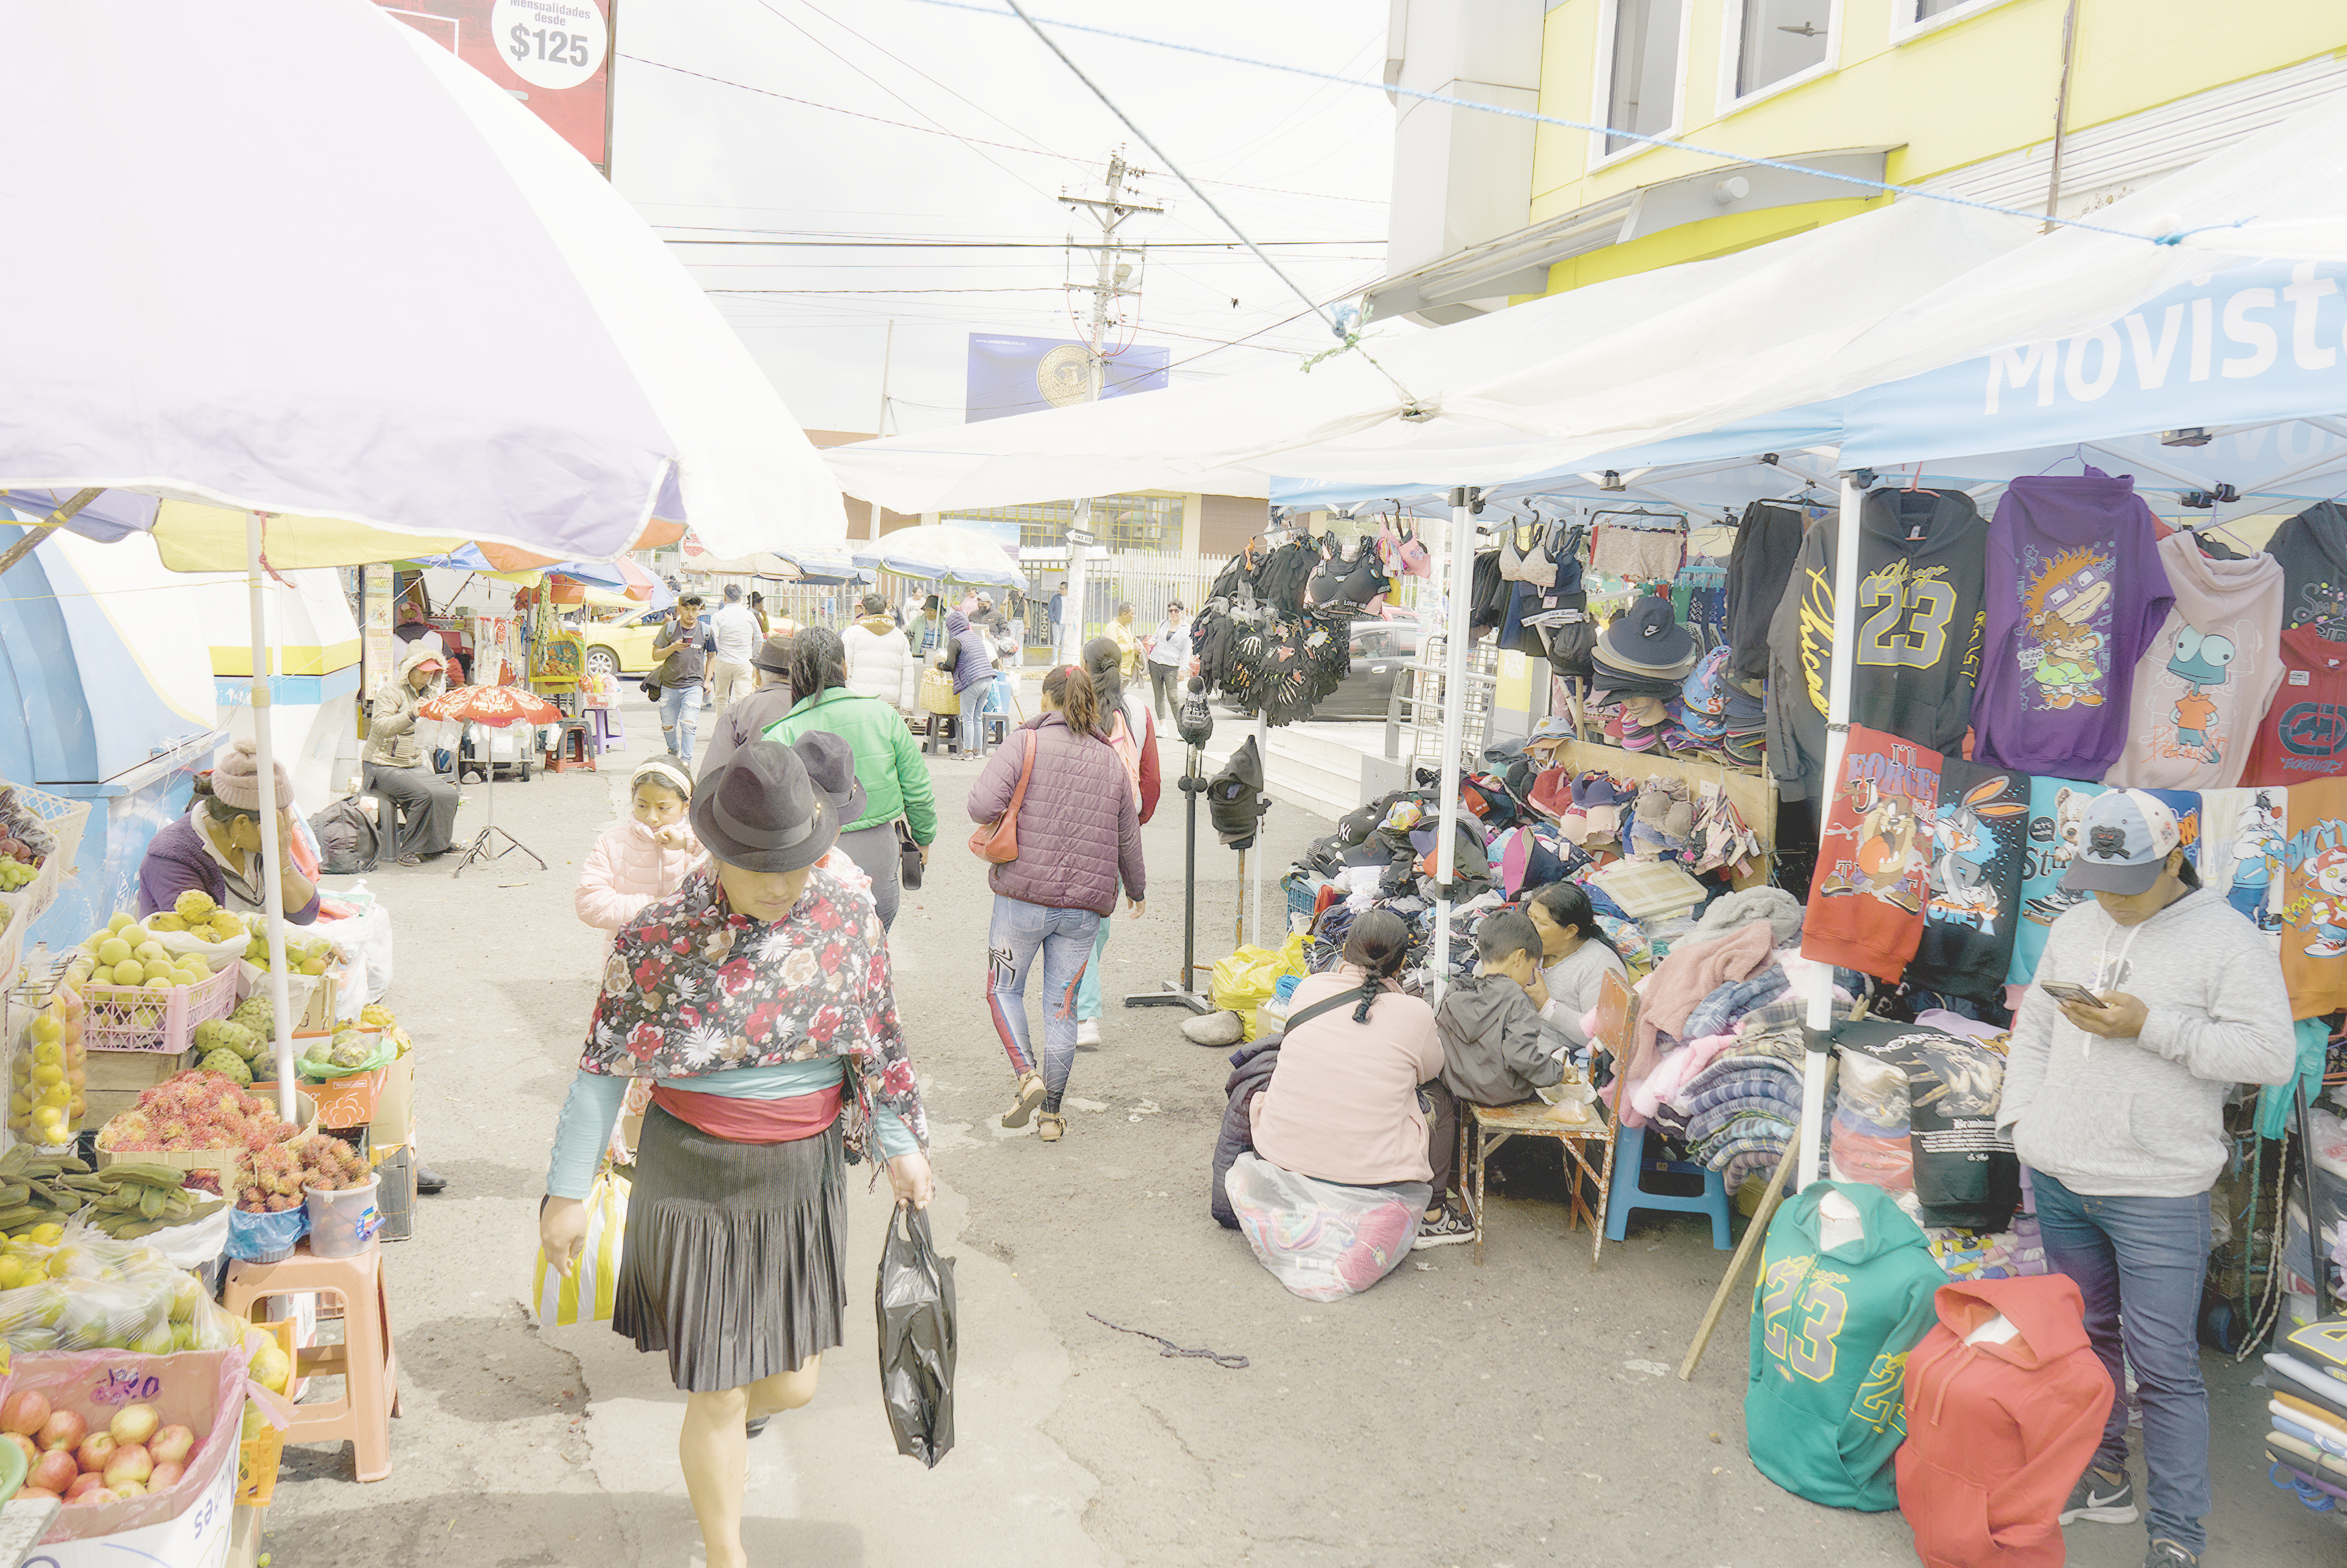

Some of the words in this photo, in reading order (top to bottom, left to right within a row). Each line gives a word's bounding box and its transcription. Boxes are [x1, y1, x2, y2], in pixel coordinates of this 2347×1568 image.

[510, 0, 591, 19] Mensualidades
[534, 12, 566, 26] desde
[509, 23, 589, 67] $125
[373, 578, 393, 587] MOTE
[1870, 558, 1949, 592] Chicago
[1857, 576, 1957, 669] 23
[369, 637, 388, 648] Bebidas
[369, 648, 392, 659] Gaseosas
[369, 659, 392, 670] Golosinas
[1762, 1259, 1849, 1383] 23
